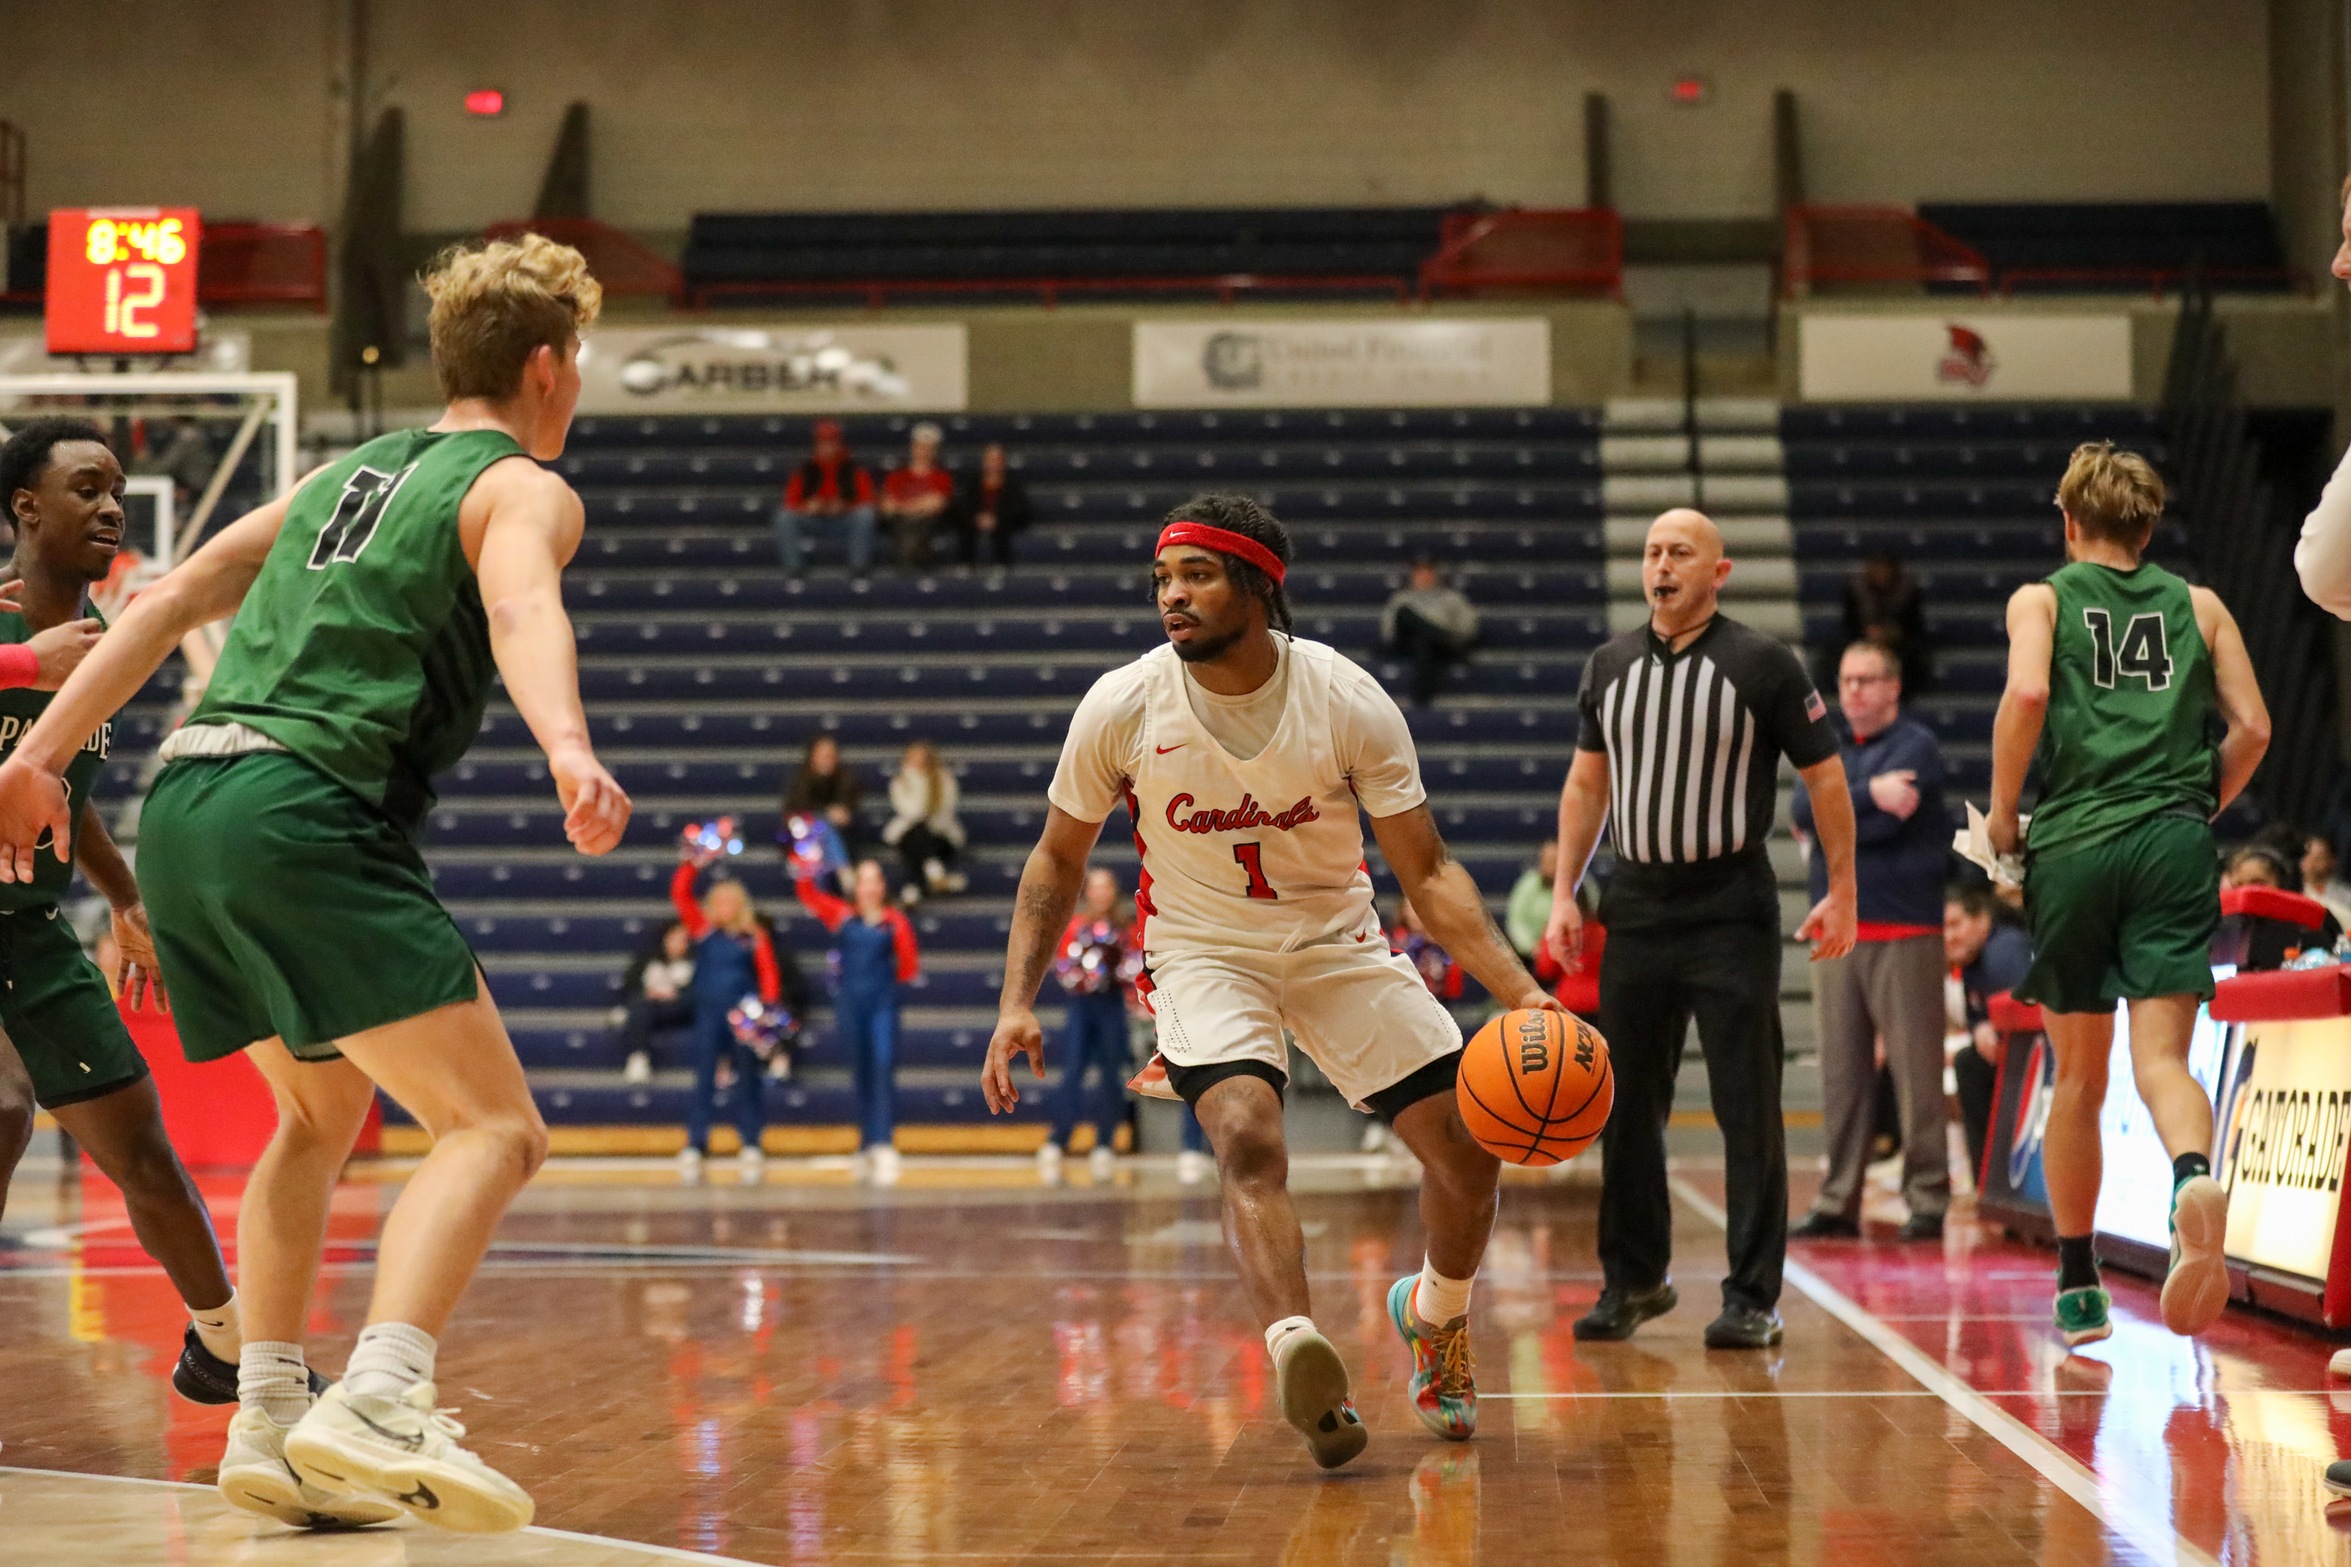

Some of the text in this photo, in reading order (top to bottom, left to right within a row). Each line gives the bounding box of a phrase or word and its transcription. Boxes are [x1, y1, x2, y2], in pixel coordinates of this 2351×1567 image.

[86, 218, 186, 264] 8:46
[104, 264, 166, 338] 12
[306, 461, 420, 570] 11
[2083, 608, 2174, 691] 14
[0, 716, 112, 760] PADE
[1165, 792, 1320, 834] Cardinals
[1232, 842, 1278, 900] 1
[1519, 1009, 1549, 1075] Wilso
[2241, 1089, 2351, 1192] GATORADE
